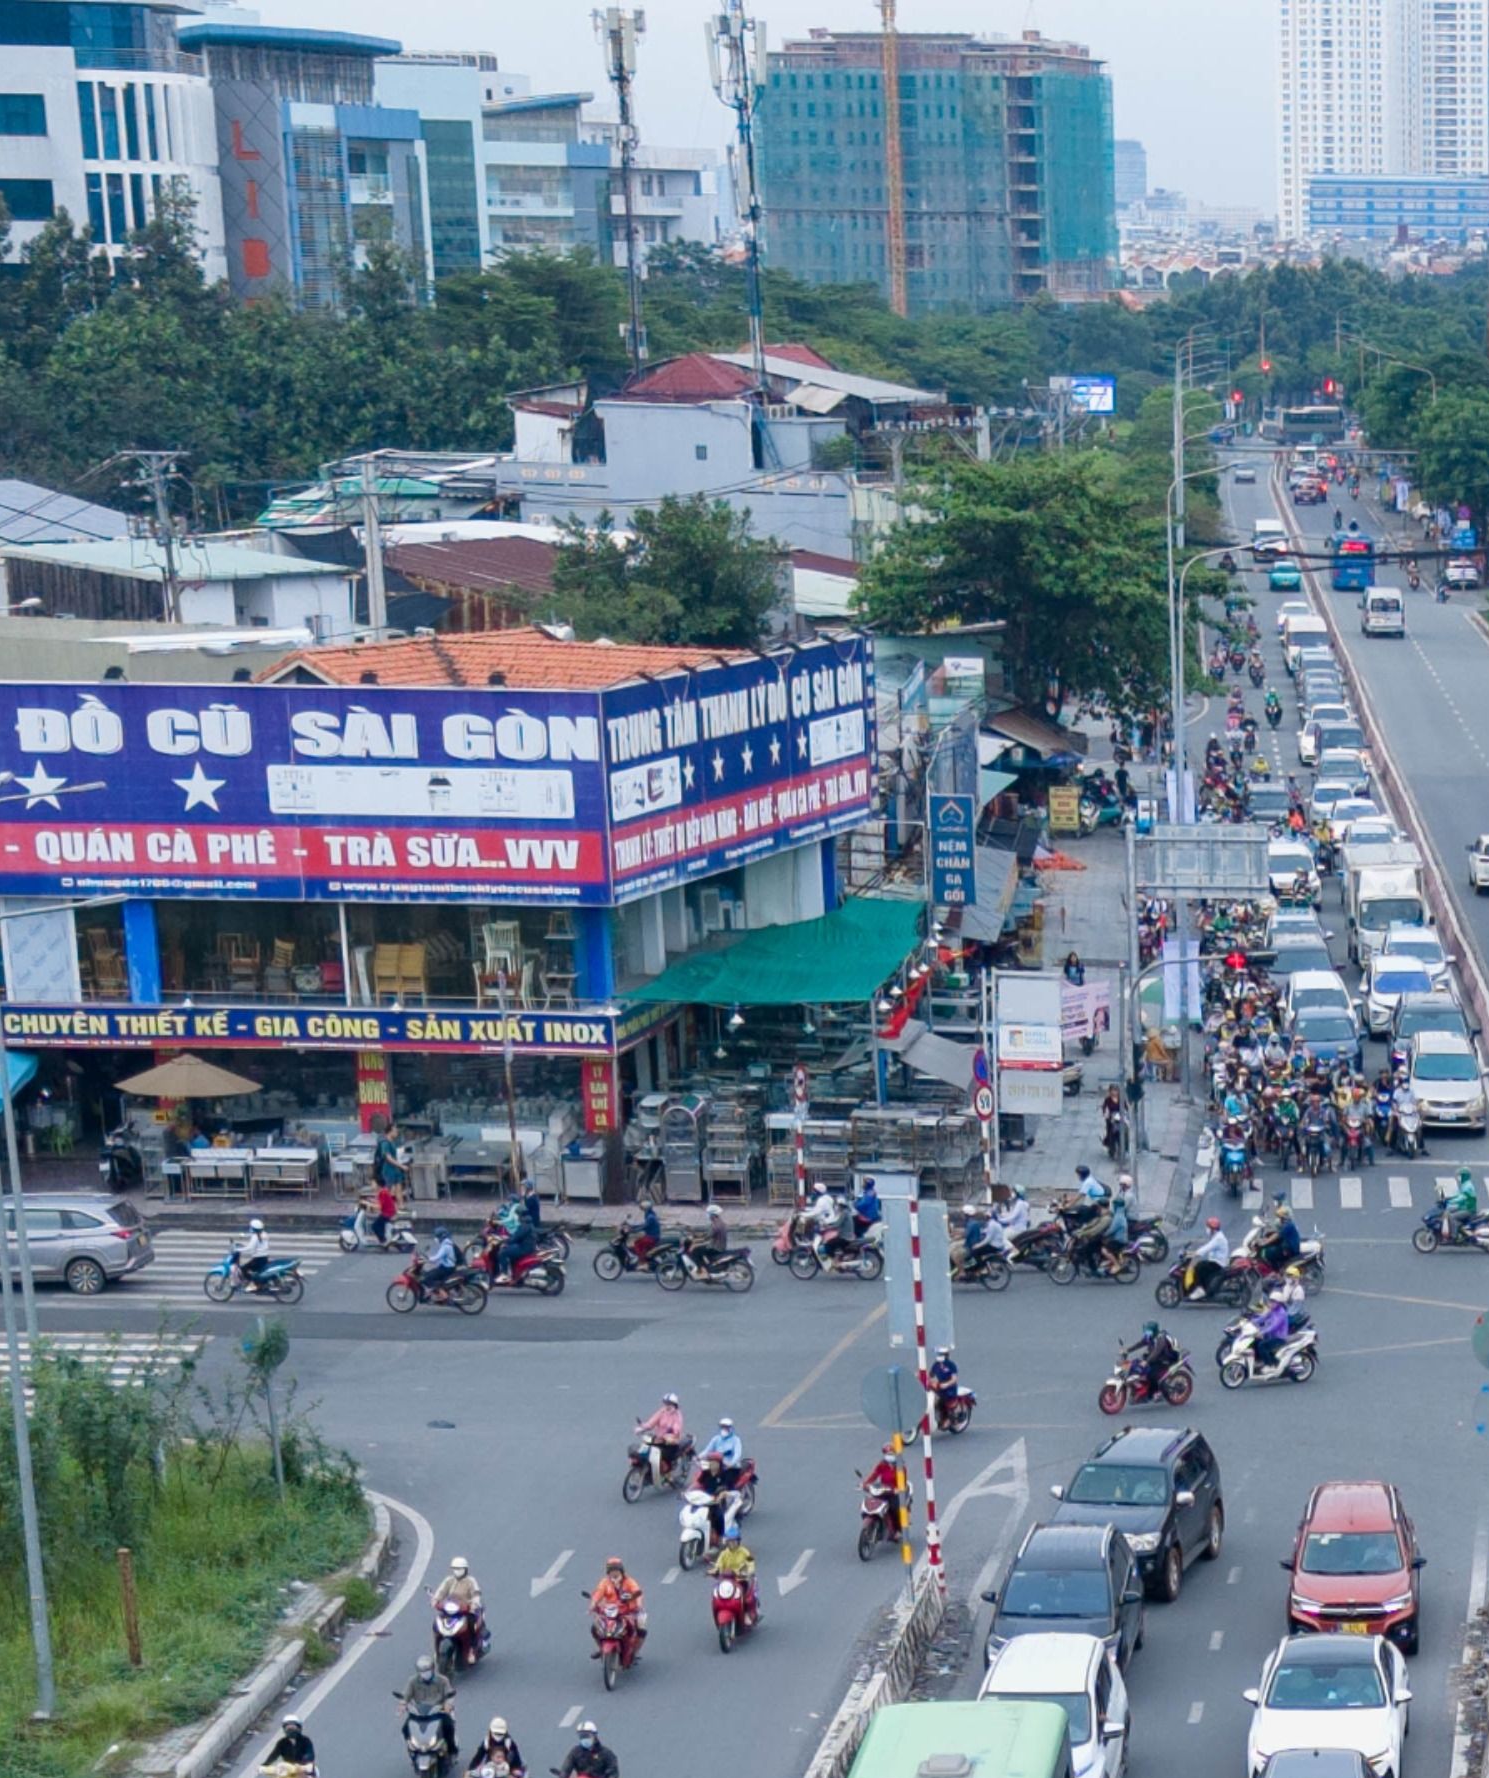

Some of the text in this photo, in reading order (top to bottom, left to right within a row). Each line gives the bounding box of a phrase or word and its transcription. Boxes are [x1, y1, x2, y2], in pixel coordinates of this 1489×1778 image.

[14, 692, 124, 755] ĐỒ
[146, 702, 253, 757] CŨ
[290, 705, 419, 760] SÀI
[442, 707, 601, 762] GÒN
[607, 707, 662, 764] TRUNG
[664, 697, 699, 748] TÂM
[35, 827, 130, 865] QUÁN
[146, 827, 199, 864] CÀ
[206, 829, 278, 865] PHÊ
[323, 831, 398, 867] TRÀ
[939, 840, 966, 854] NỆM
[4, 1009, 607, 1045] CHUYÊN THIẾT KẾ GIA CÔNG SẢN XUẤT INOX
